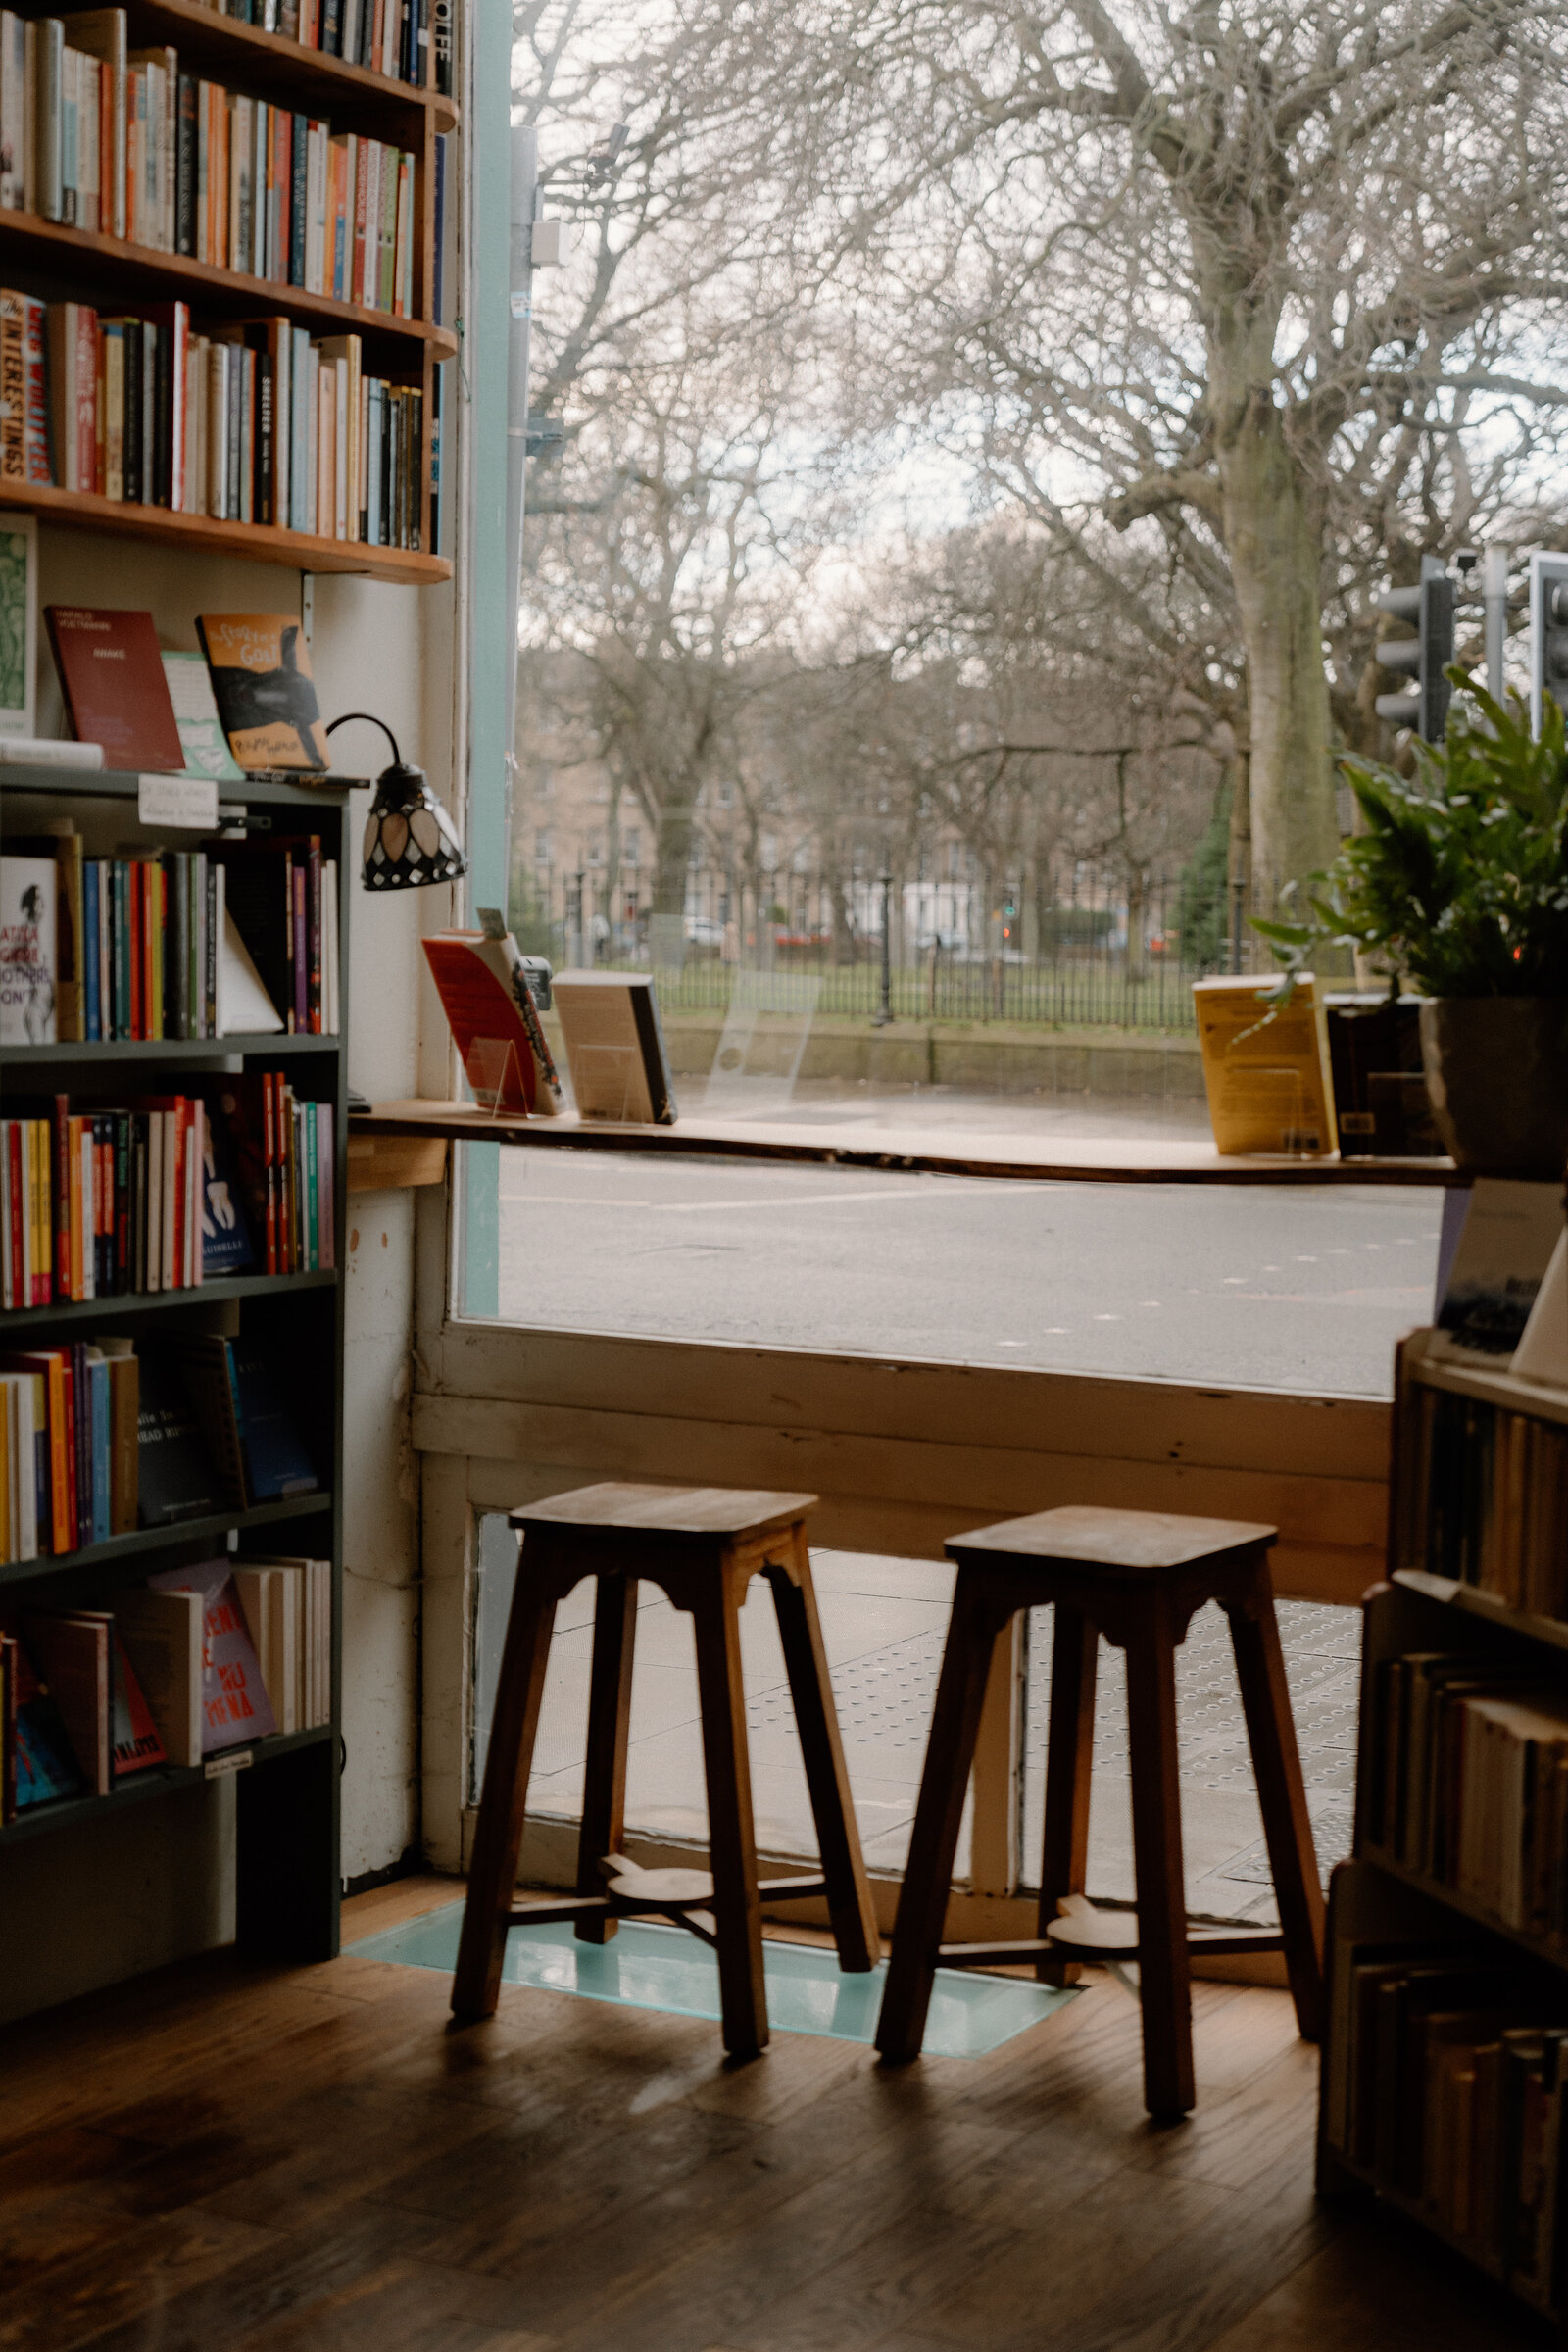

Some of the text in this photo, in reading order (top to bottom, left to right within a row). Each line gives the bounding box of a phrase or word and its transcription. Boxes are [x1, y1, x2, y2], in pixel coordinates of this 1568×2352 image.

[434, 0, 452, 63] OLFE
[4, 319, 24, 476] INTERESTINGS
[28, 362, 50, 481] WOLITZER
[261, 376, 271, 433] SHELTER
[0, 966, 50, 985] OTHERS
[0, 988, 37, 1005] ON'T
